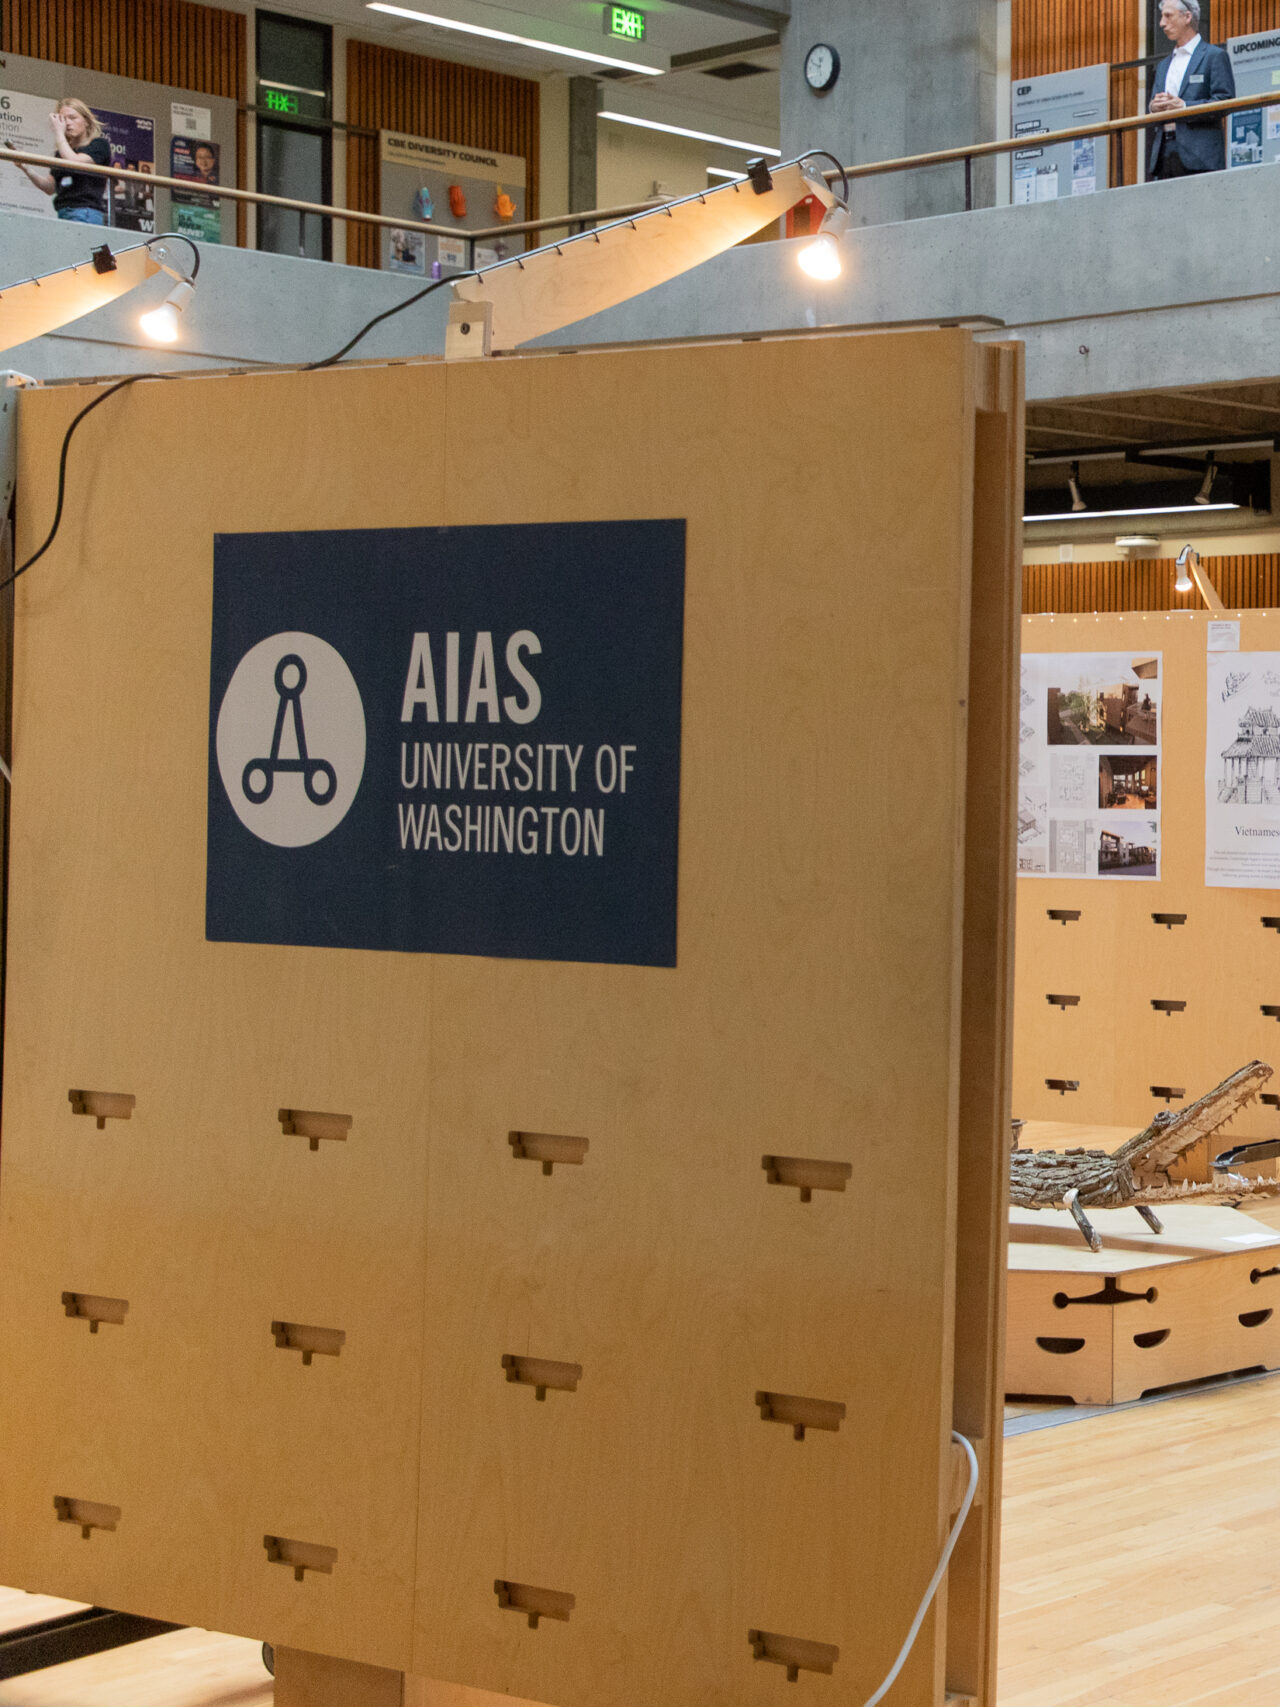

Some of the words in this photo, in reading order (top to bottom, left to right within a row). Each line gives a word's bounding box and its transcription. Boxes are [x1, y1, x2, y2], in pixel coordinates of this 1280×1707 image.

[612, 7, 644, 38] EXIT
[1233, 38, 1280, 54] UPCOMING
[1017, 86, 1031, 95] CEP
[388, 138, 406, 149] CBE
[408, 142, 458, 158] DIVERSITY
[459, 152, 498, 167] COUNCIL
[139, 219, 154, 231] W
[401, 629, 543, 725] AIAS
[401, 742, 584, 792] UNIVERSITY
[595, 745, 637, 794] OF
[399, 804, 605, 857] WASHINGTON
